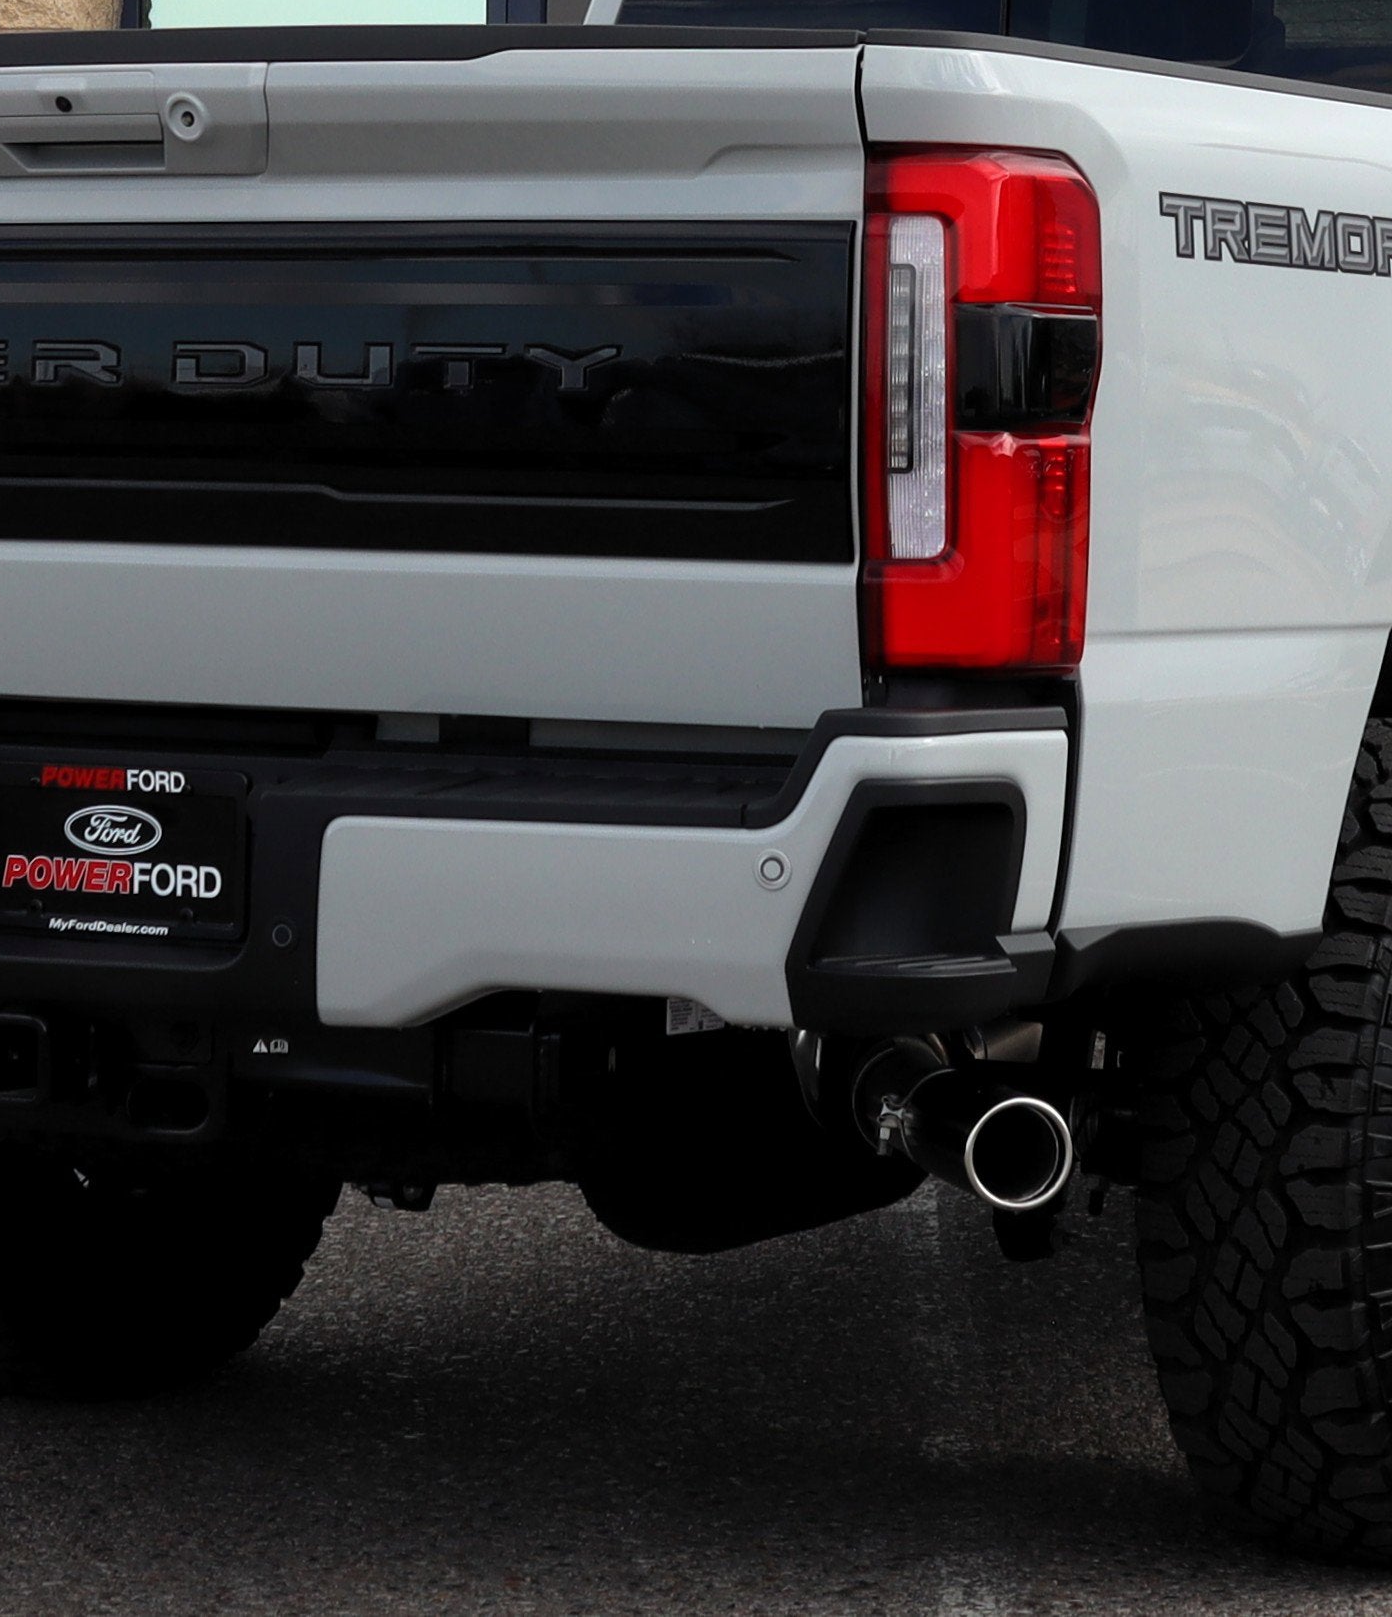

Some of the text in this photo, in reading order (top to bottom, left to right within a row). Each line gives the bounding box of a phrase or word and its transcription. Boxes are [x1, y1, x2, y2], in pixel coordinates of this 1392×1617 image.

[173, 339, 623, 389] DUTY
[84, 813, 142, 844] Ford
[48, 917, 169, 936] MyFordDealer.com
